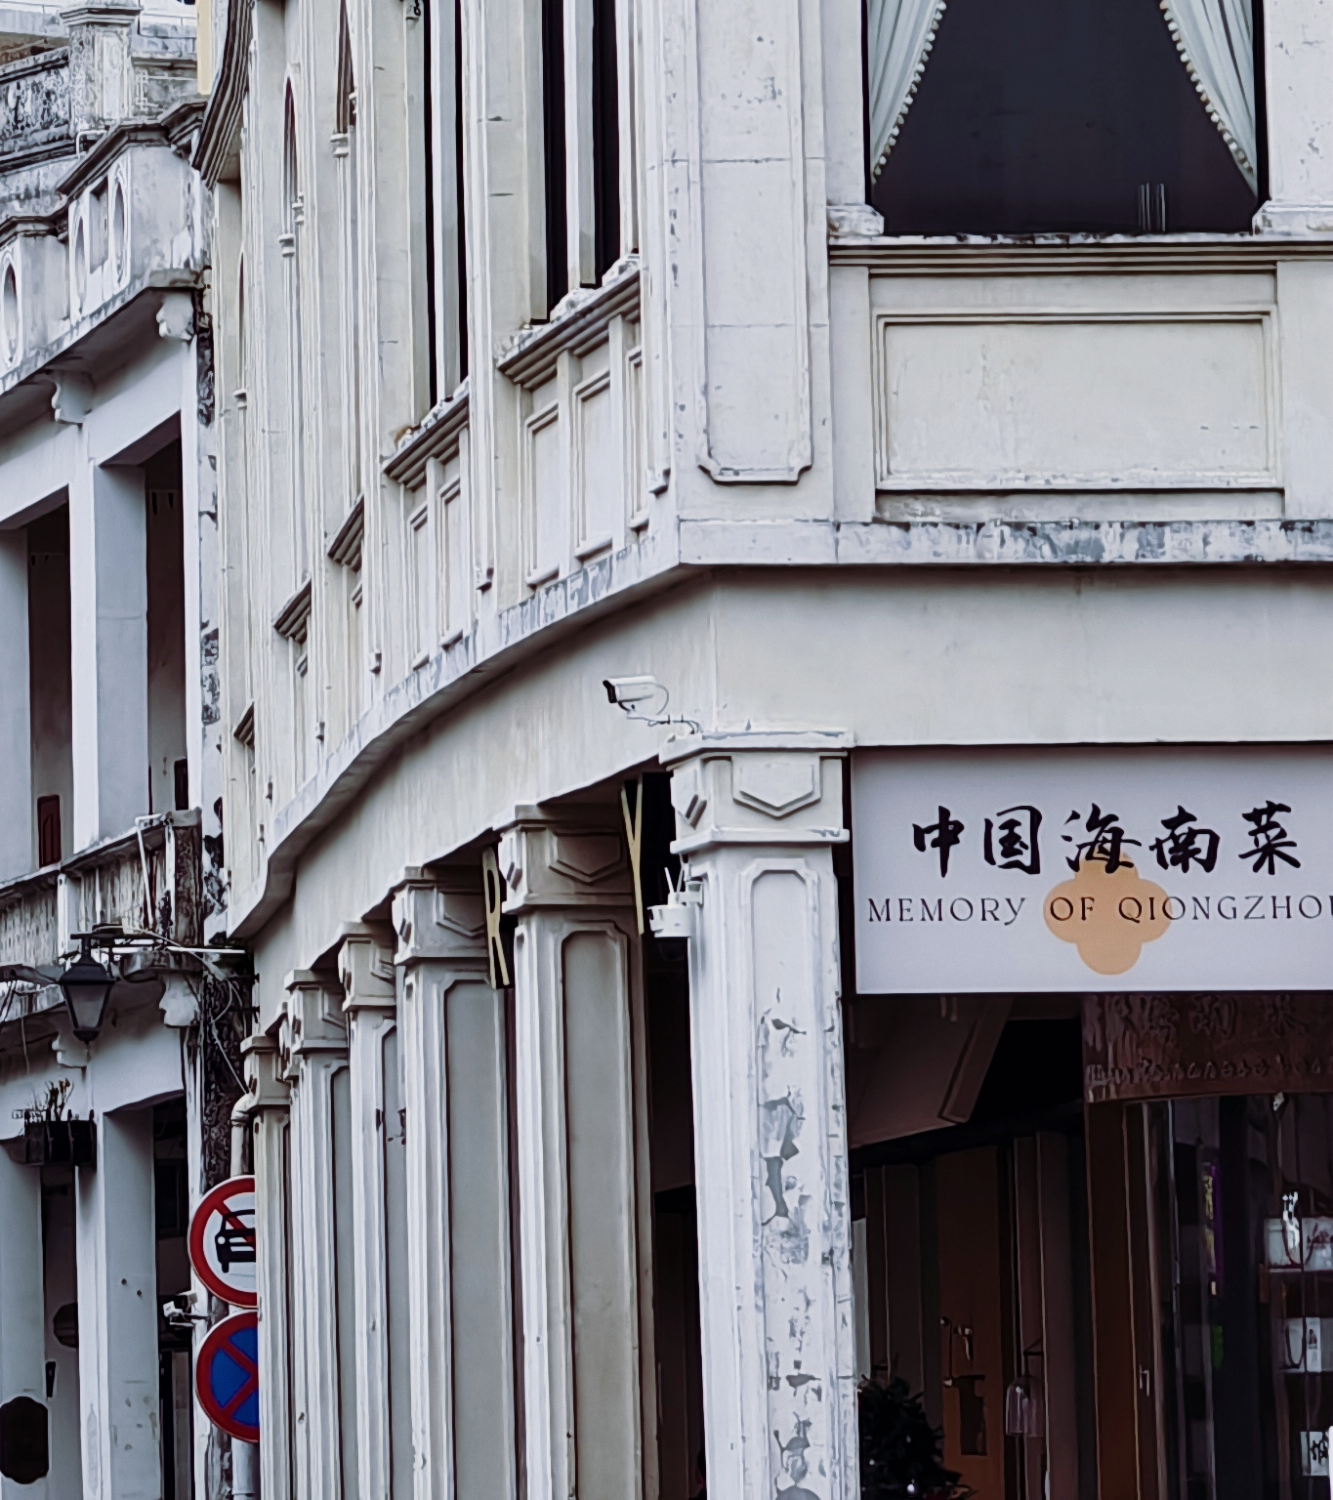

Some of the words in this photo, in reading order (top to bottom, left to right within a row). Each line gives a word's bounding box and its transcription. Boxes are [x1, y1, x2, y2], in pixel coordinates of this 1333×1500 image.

[912, 800, 1301, 878] 中国海南菜
[868, 897, 1027, 926] MEMORY
[1050, 897, 1095, 922] OF
[1118, 894, 1333, 923] QIONGZHO
